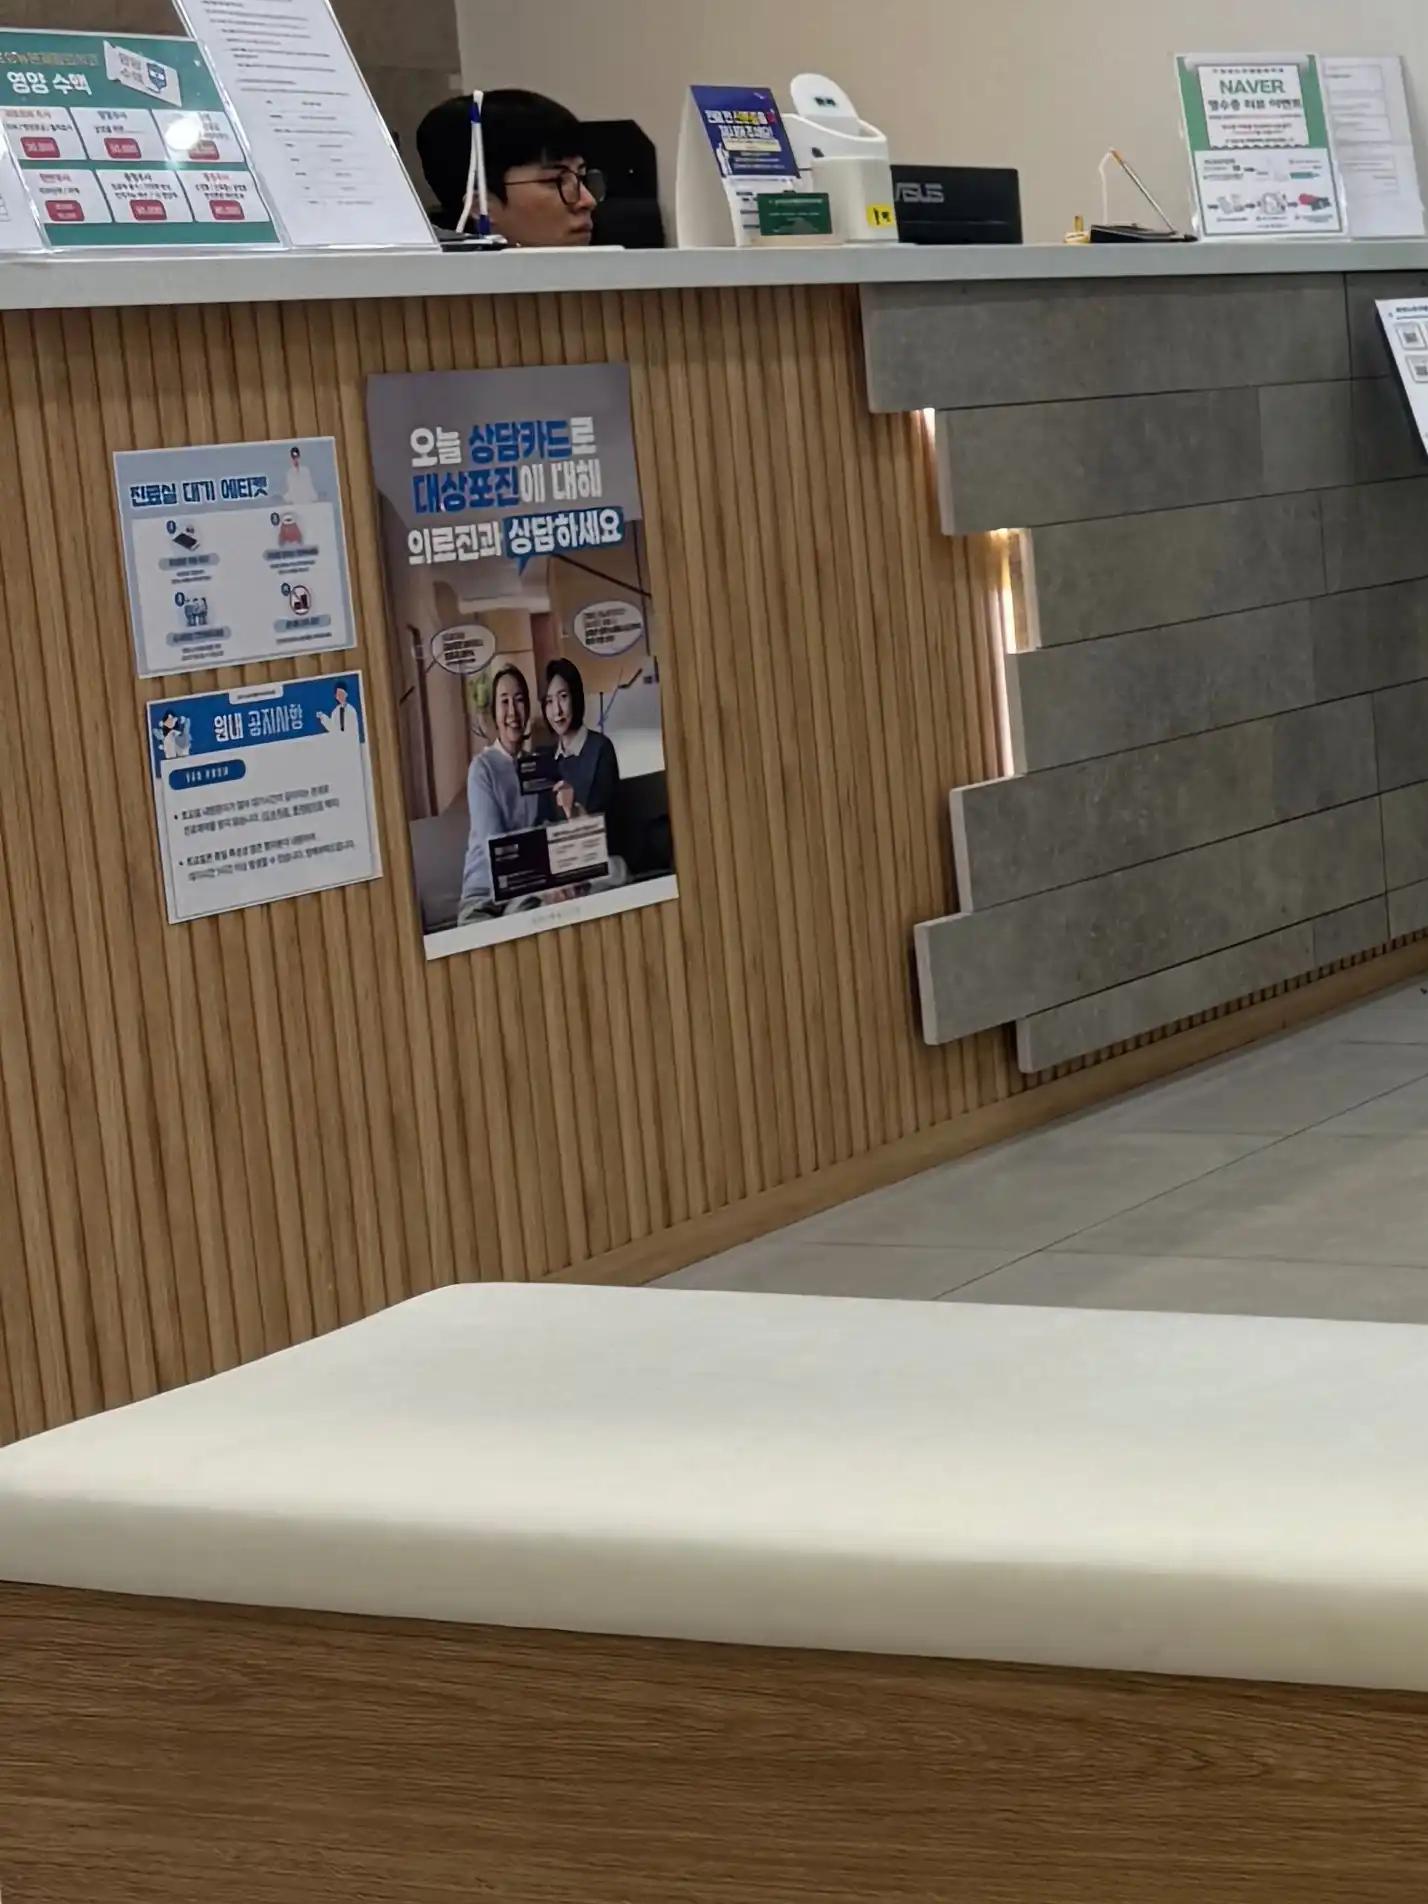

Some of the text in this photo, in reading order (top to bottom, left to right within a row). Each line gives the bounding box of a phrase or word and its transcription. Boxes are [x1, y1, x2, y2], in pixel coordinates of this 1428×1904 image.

[7, 71, 51, 94] 영양
[1219, 79, 1286, 94] NAVER
[409, 415, 598, 468] 오늘 상담카드로
[130, 475, 269, 508] 진료실 대기 에티켓
[411, 457, 604, 514] 대상포진에 대해
[407, 507, 624, 566] 의료진과 상담하세요
[213, 702, 304, 743] 원내 공지사항
